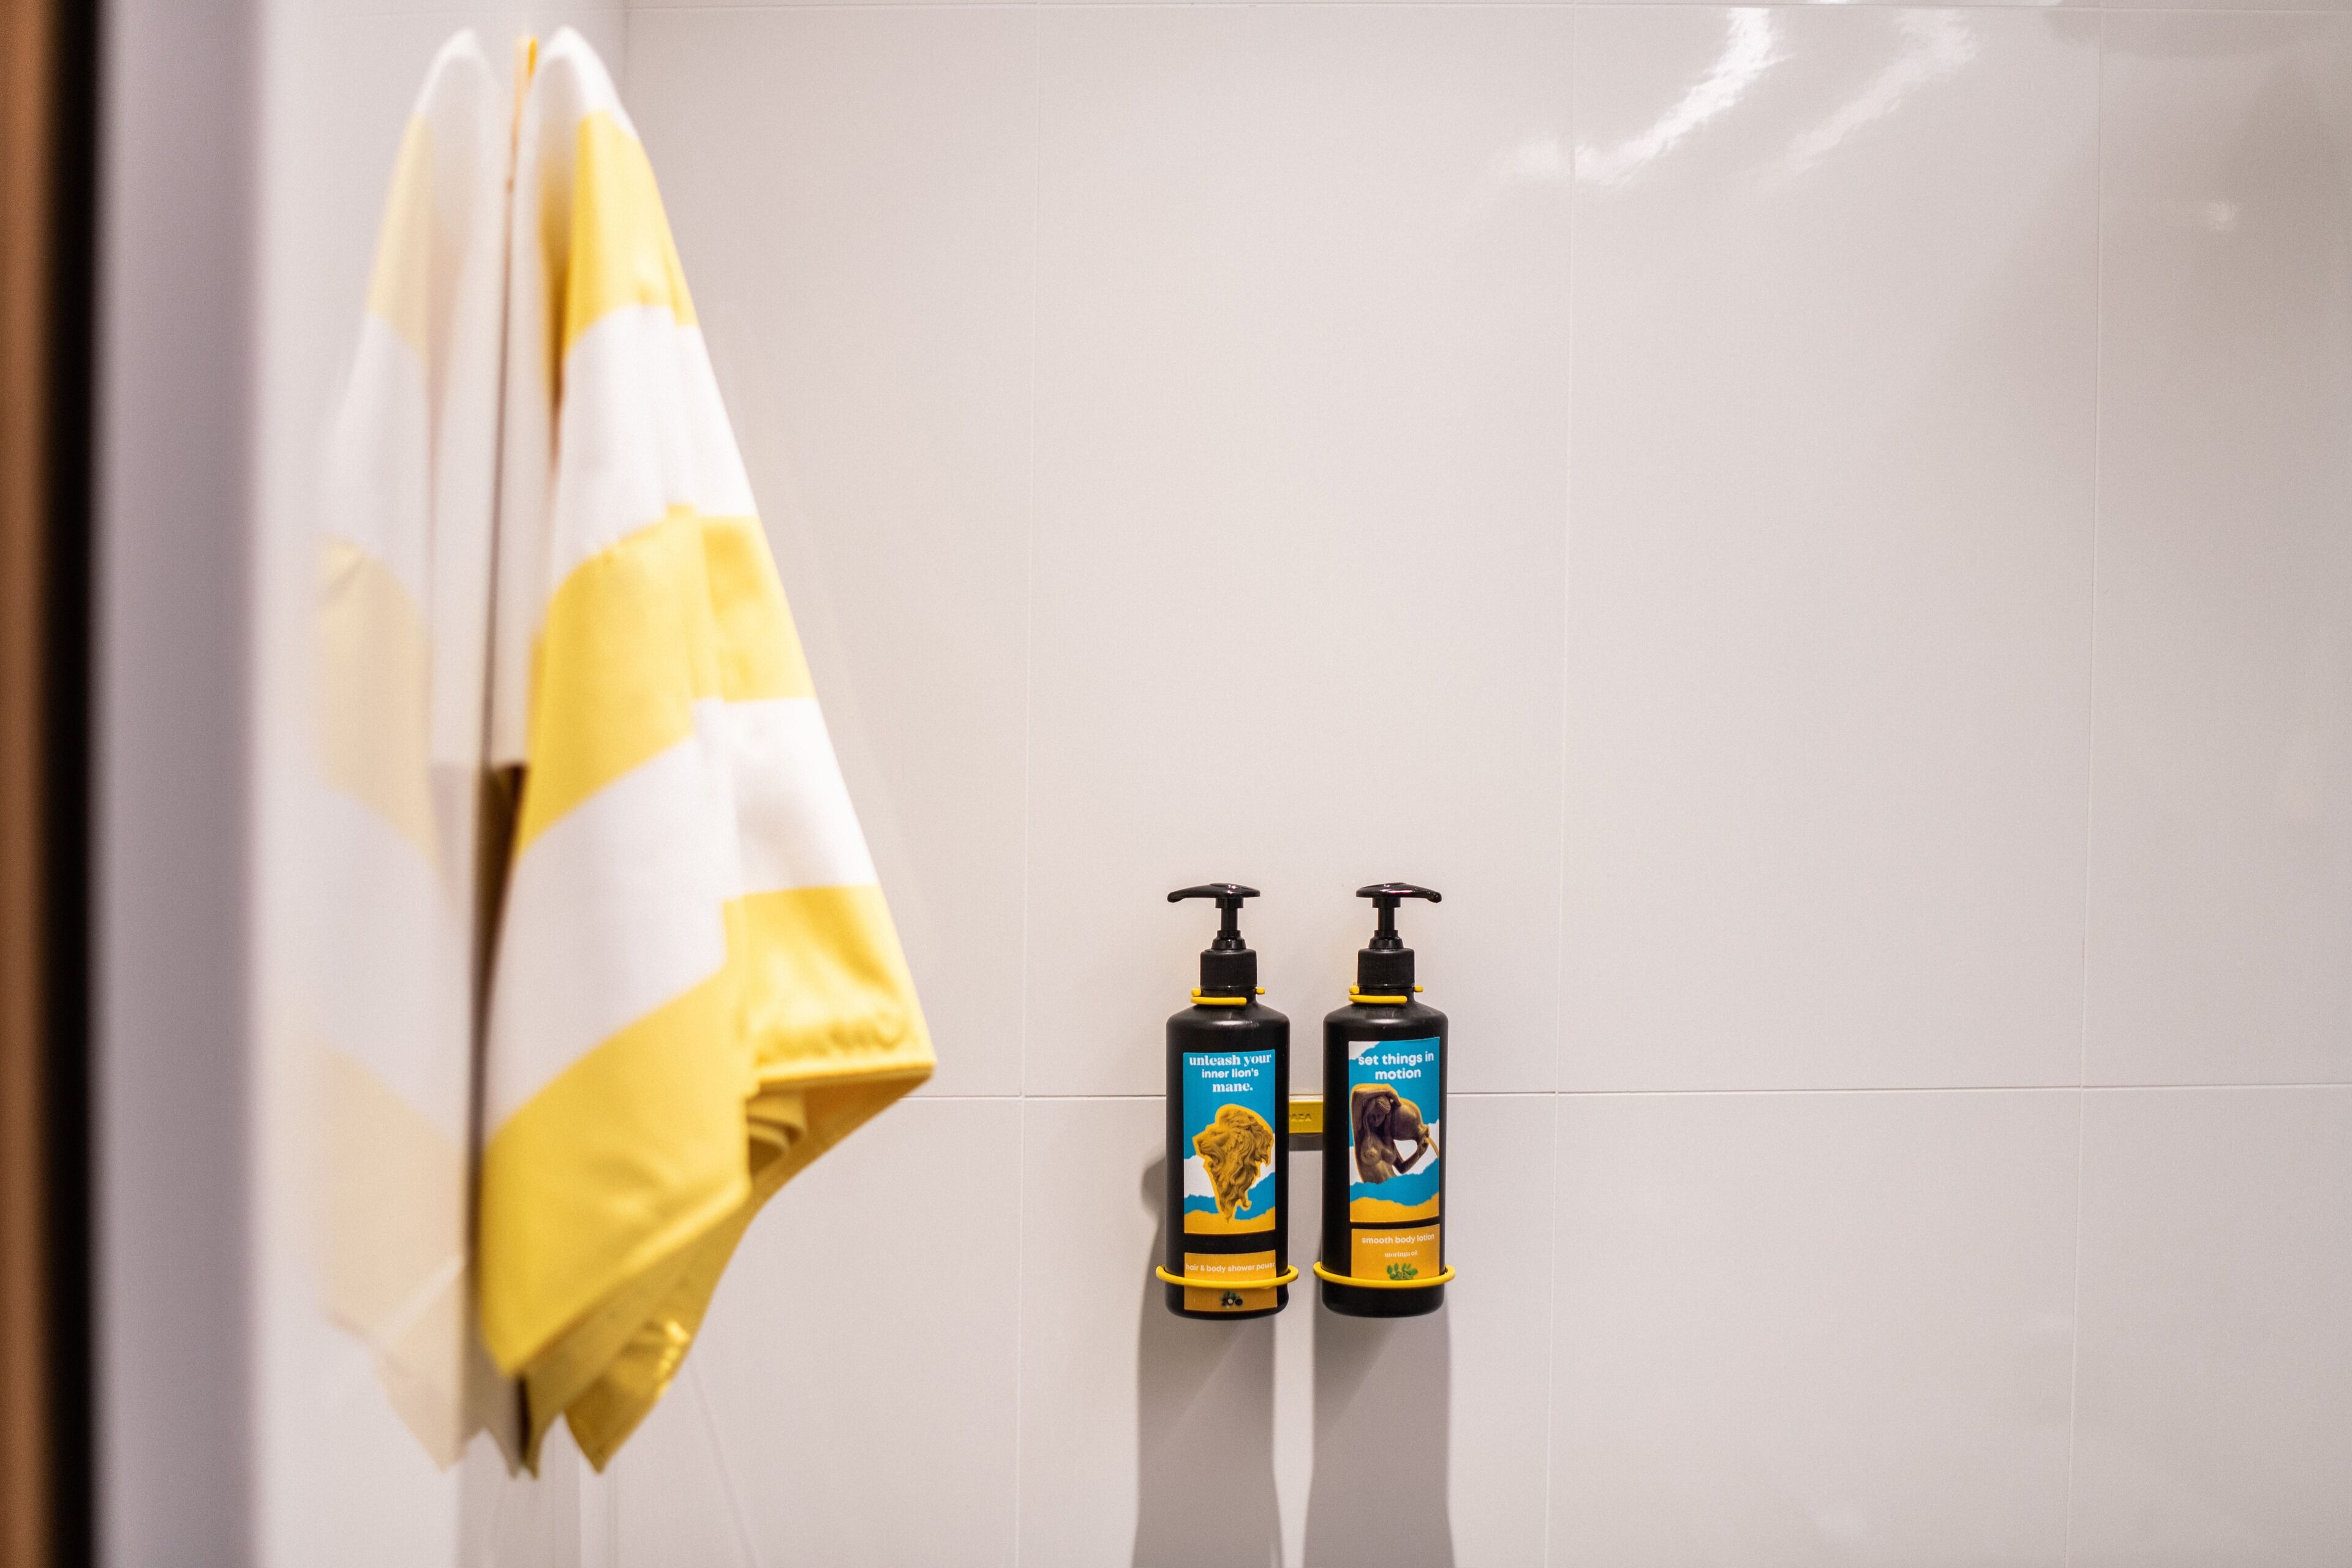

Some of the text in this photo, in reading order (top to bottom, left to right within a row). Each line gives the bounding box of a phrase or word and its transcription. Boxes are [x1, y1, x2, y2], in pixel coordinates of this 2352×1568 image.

[1189, 1054, 1272, 1067] unleash your
[1358, 1050, 1434, 1066] set things in
[1202, 1068, 1259, 1078] inner lion's
[1375, 1068, 1422, 1080] motion
[1212, 1082, 1253, 1093] mane.
[1395, 1235, 1415, 1244] body
[1417, 1234, 1434, 1242] lotion
[1206, 1264, 1226, 1273] body
[1256, 1262, 1275, 1272] power
